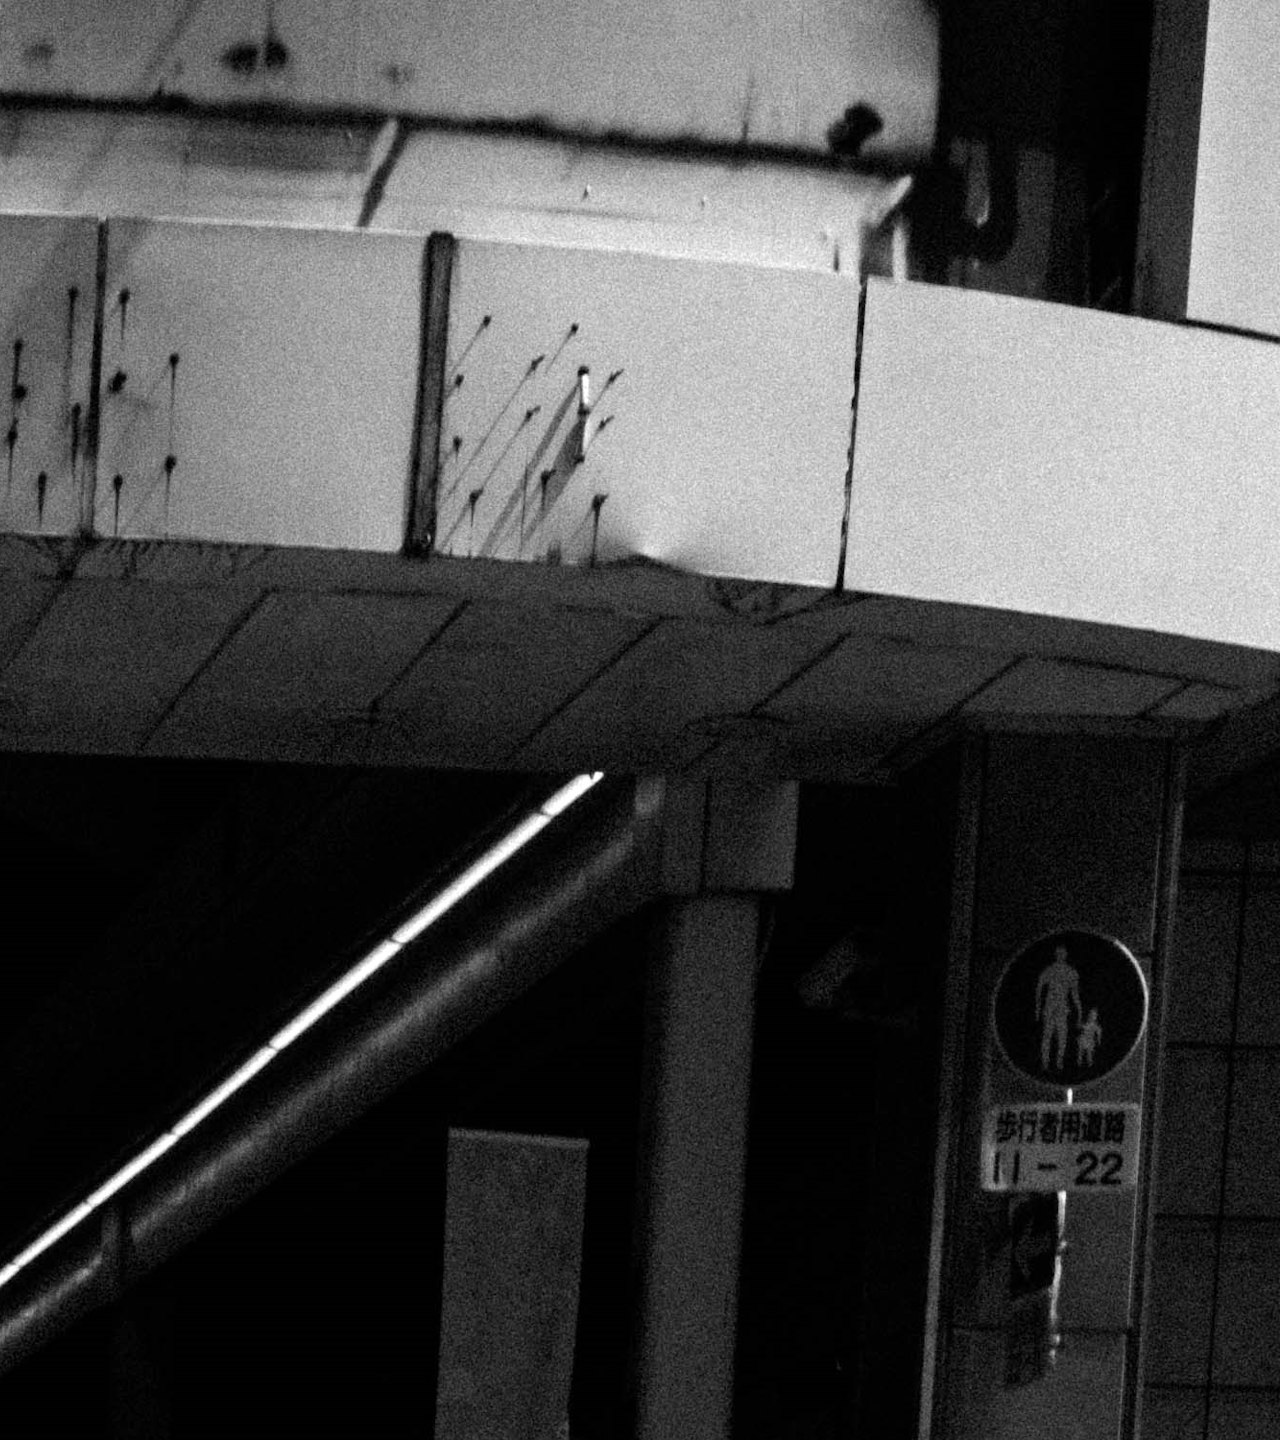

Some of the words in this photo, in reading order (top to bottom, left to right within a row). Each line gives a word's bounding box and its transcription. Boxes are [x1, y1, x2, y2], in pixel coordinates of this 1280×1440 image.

[995, 1110, 1126, 1144] 歩行者用道路
